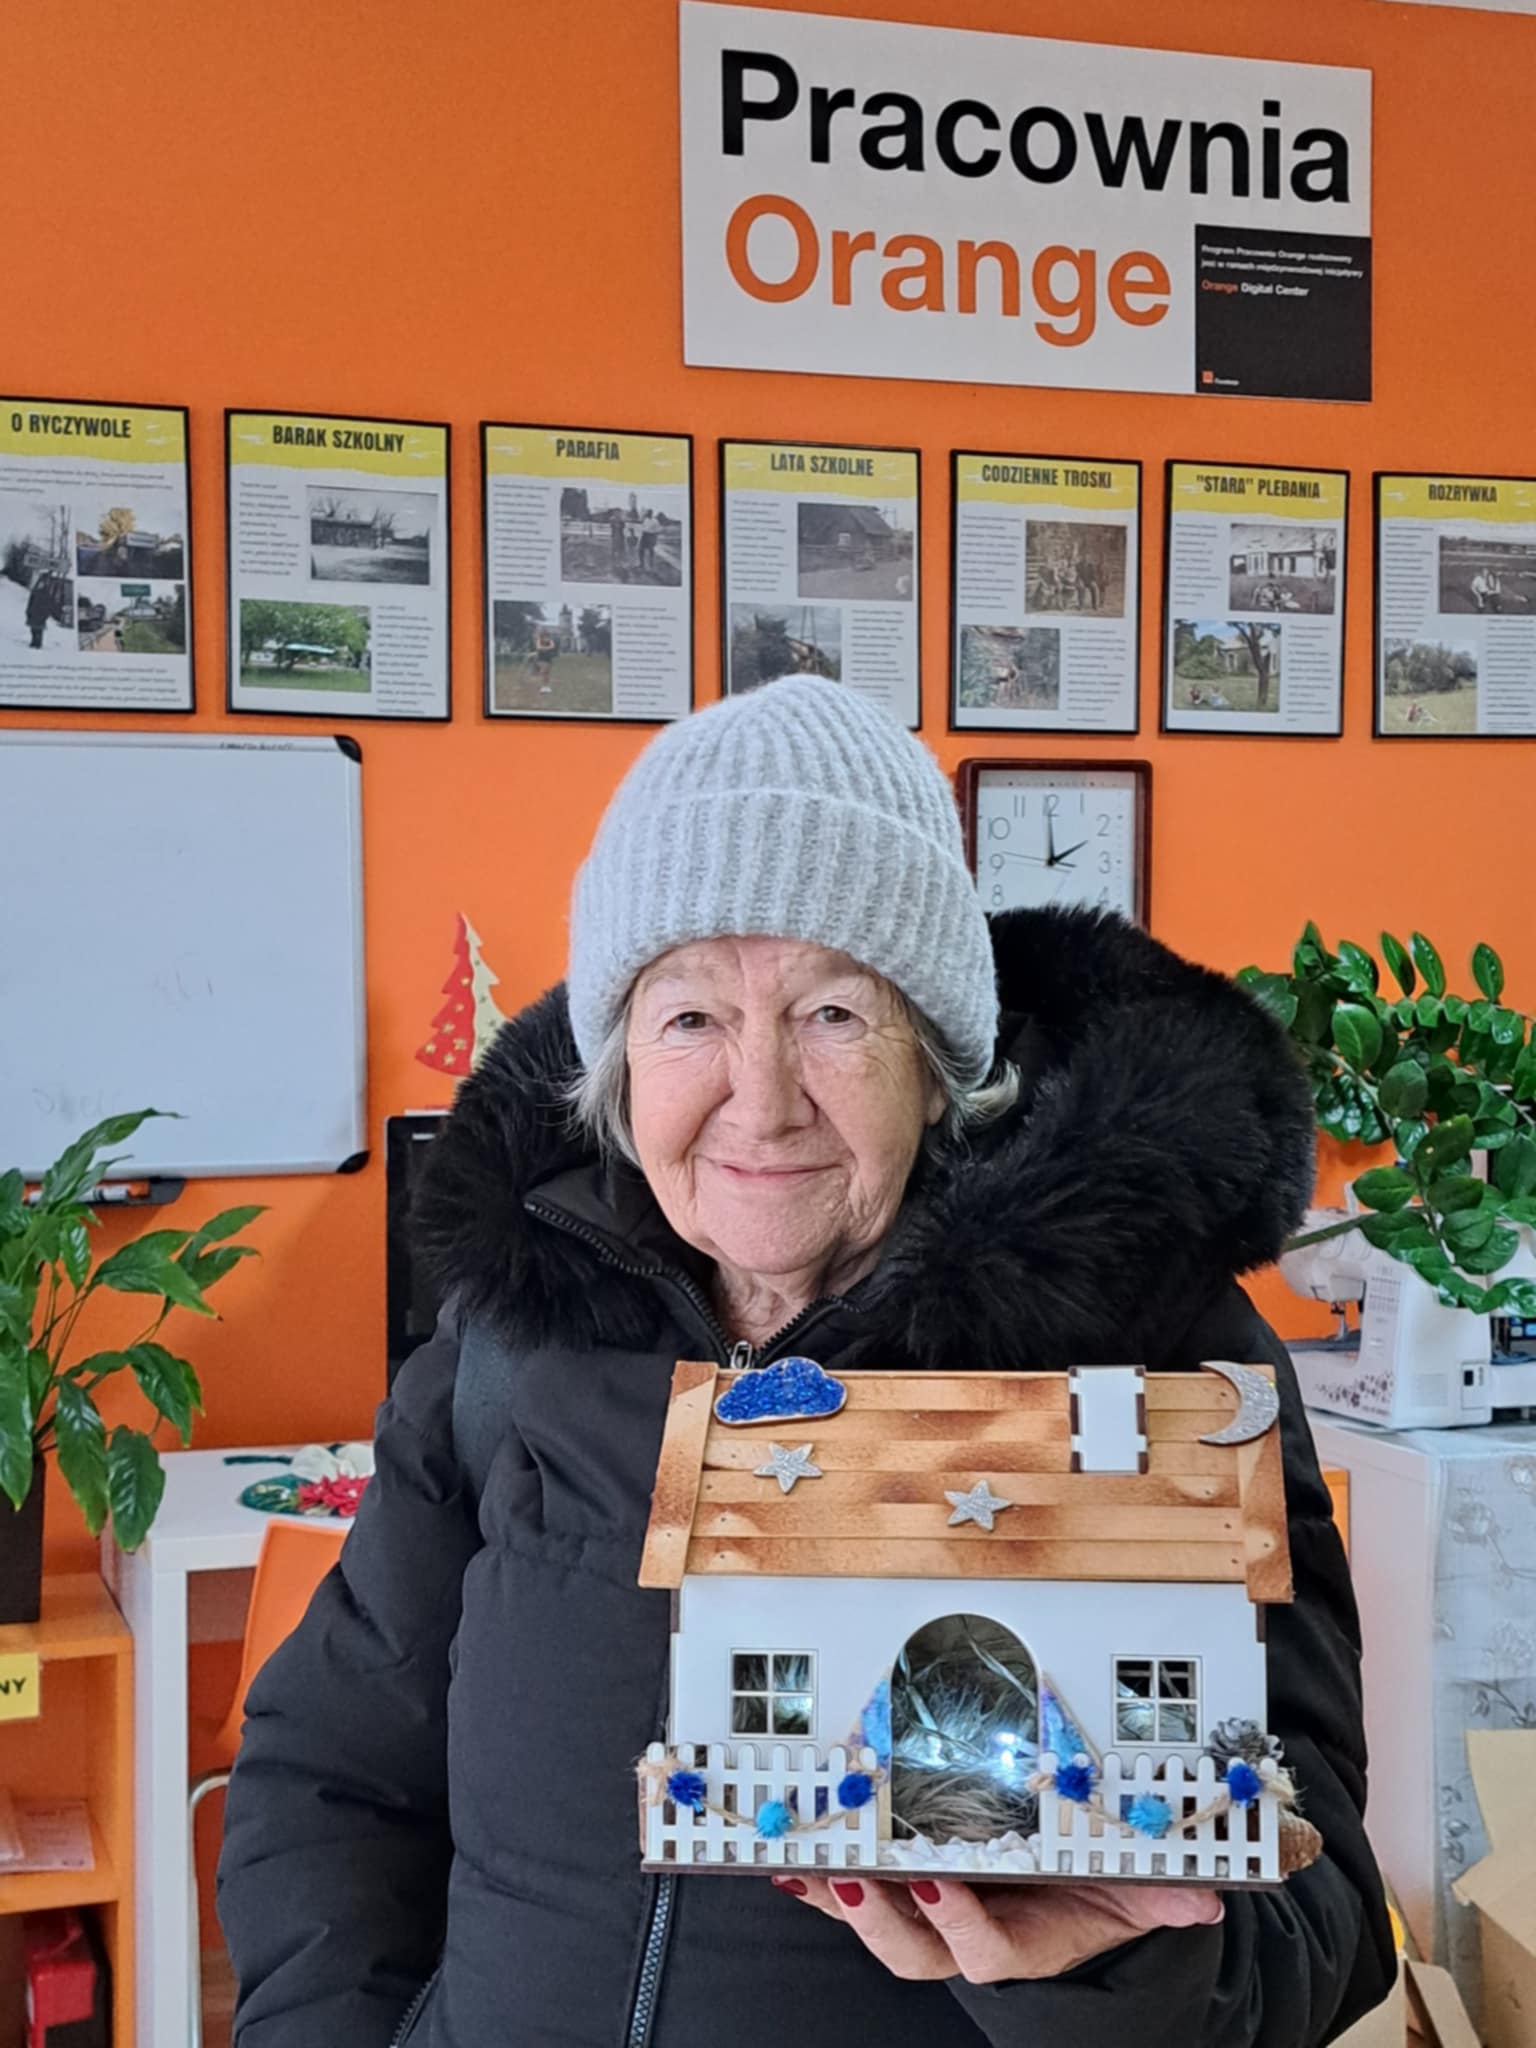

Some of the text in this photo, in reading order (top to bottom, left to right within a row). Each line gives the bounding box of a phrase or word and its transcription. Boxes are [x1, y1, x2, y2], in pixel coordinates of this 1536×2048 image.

[720, 49, 1352, 203] Pracownia
[725, 193, 1172, 347] Orange
[1201, 279, 1309, 296] Orange Digital Center
[12, 413, 131, 438] O RYCZYWOLE
[273, 425, 405, 453] BARAK SZKOLNY
[556, 438, 620, 460] PARAFIA
[771, 453, 874, 476] LATA SZKOLNE
[982, 464, 1112, 489] CODZIENNE TROSKI
[1196, 475, 1320, 498] "STARA" PLEBANIA
[1428, 484, 1498, 503] ROZRYWKA
[1013, 795, 1025, 818] 11
[1043, 793, 1060, 817] 12
[1079, 792, 1085, 815] 1
[987, 817, 1011, 840] 10
[1096, 813, 1110, 837] 2
[989, 853, 1005, 876] 9
[1098, 851, 1111, 874] 3
[992, 883, 1005, 907] 8
